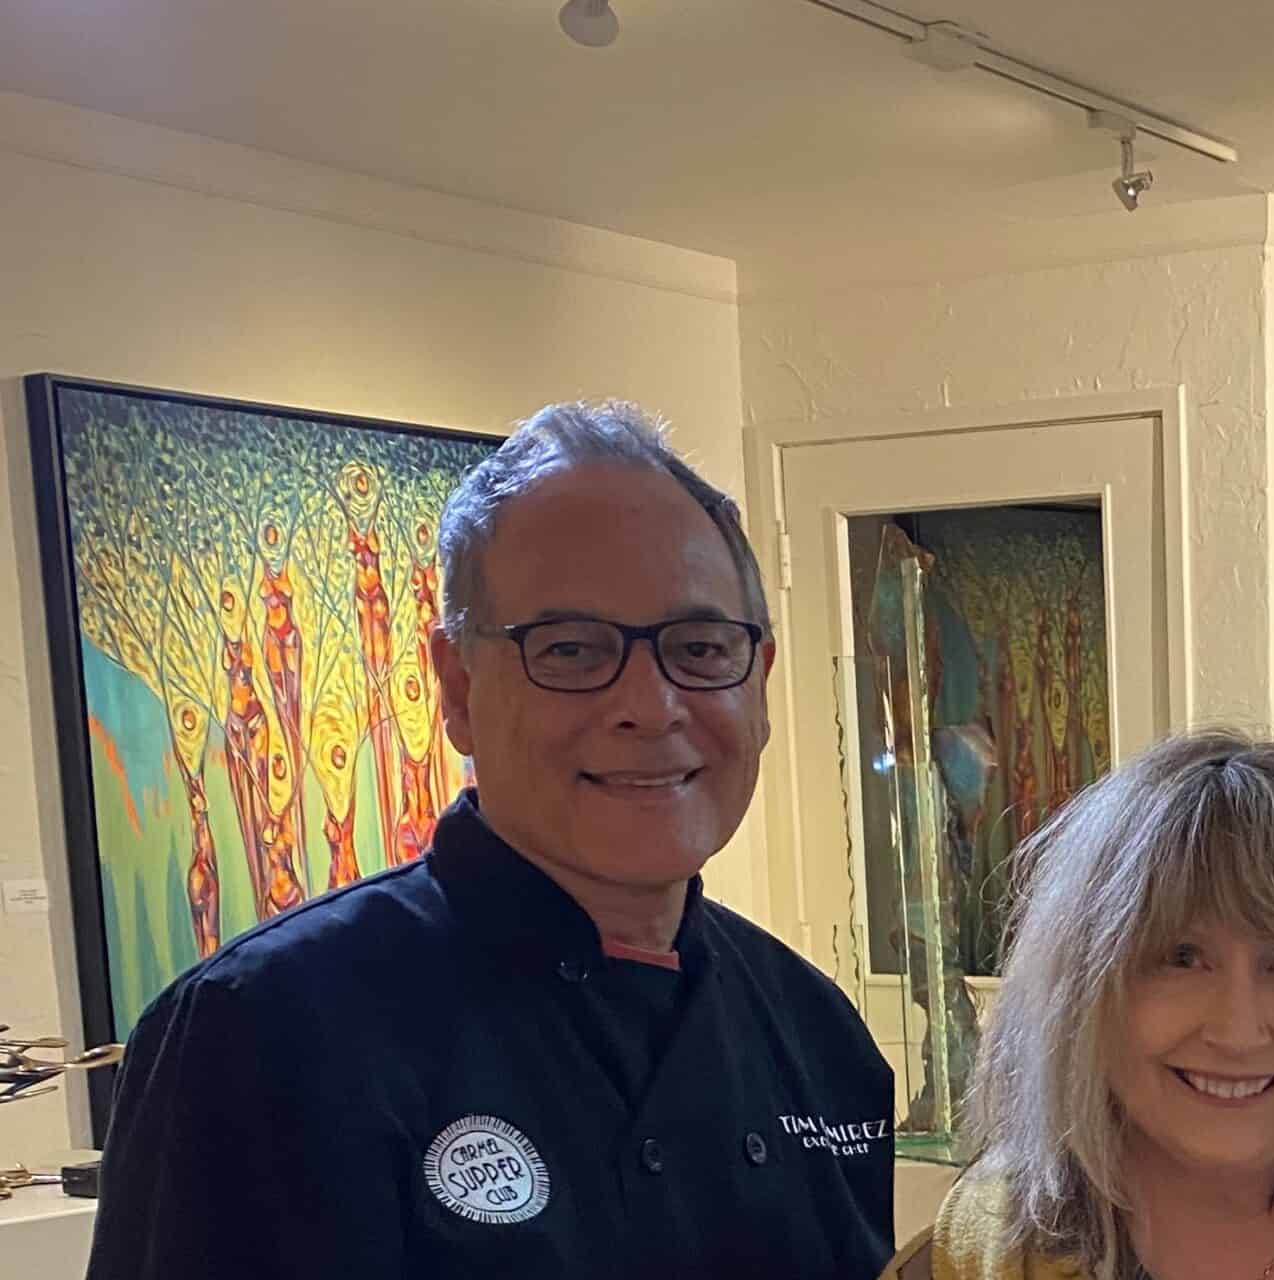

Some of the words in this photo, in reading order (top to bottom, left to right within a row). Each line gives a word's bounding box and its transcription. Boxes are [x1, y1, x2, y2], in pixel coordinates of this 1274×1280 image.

[778, 1115, 818, 1134] TIM
[451, 1138, 502, 1166] CARMEL
[448, 1156, 525, 1199] SUPPER
[486, 1185, 518, 1205] CLUB
